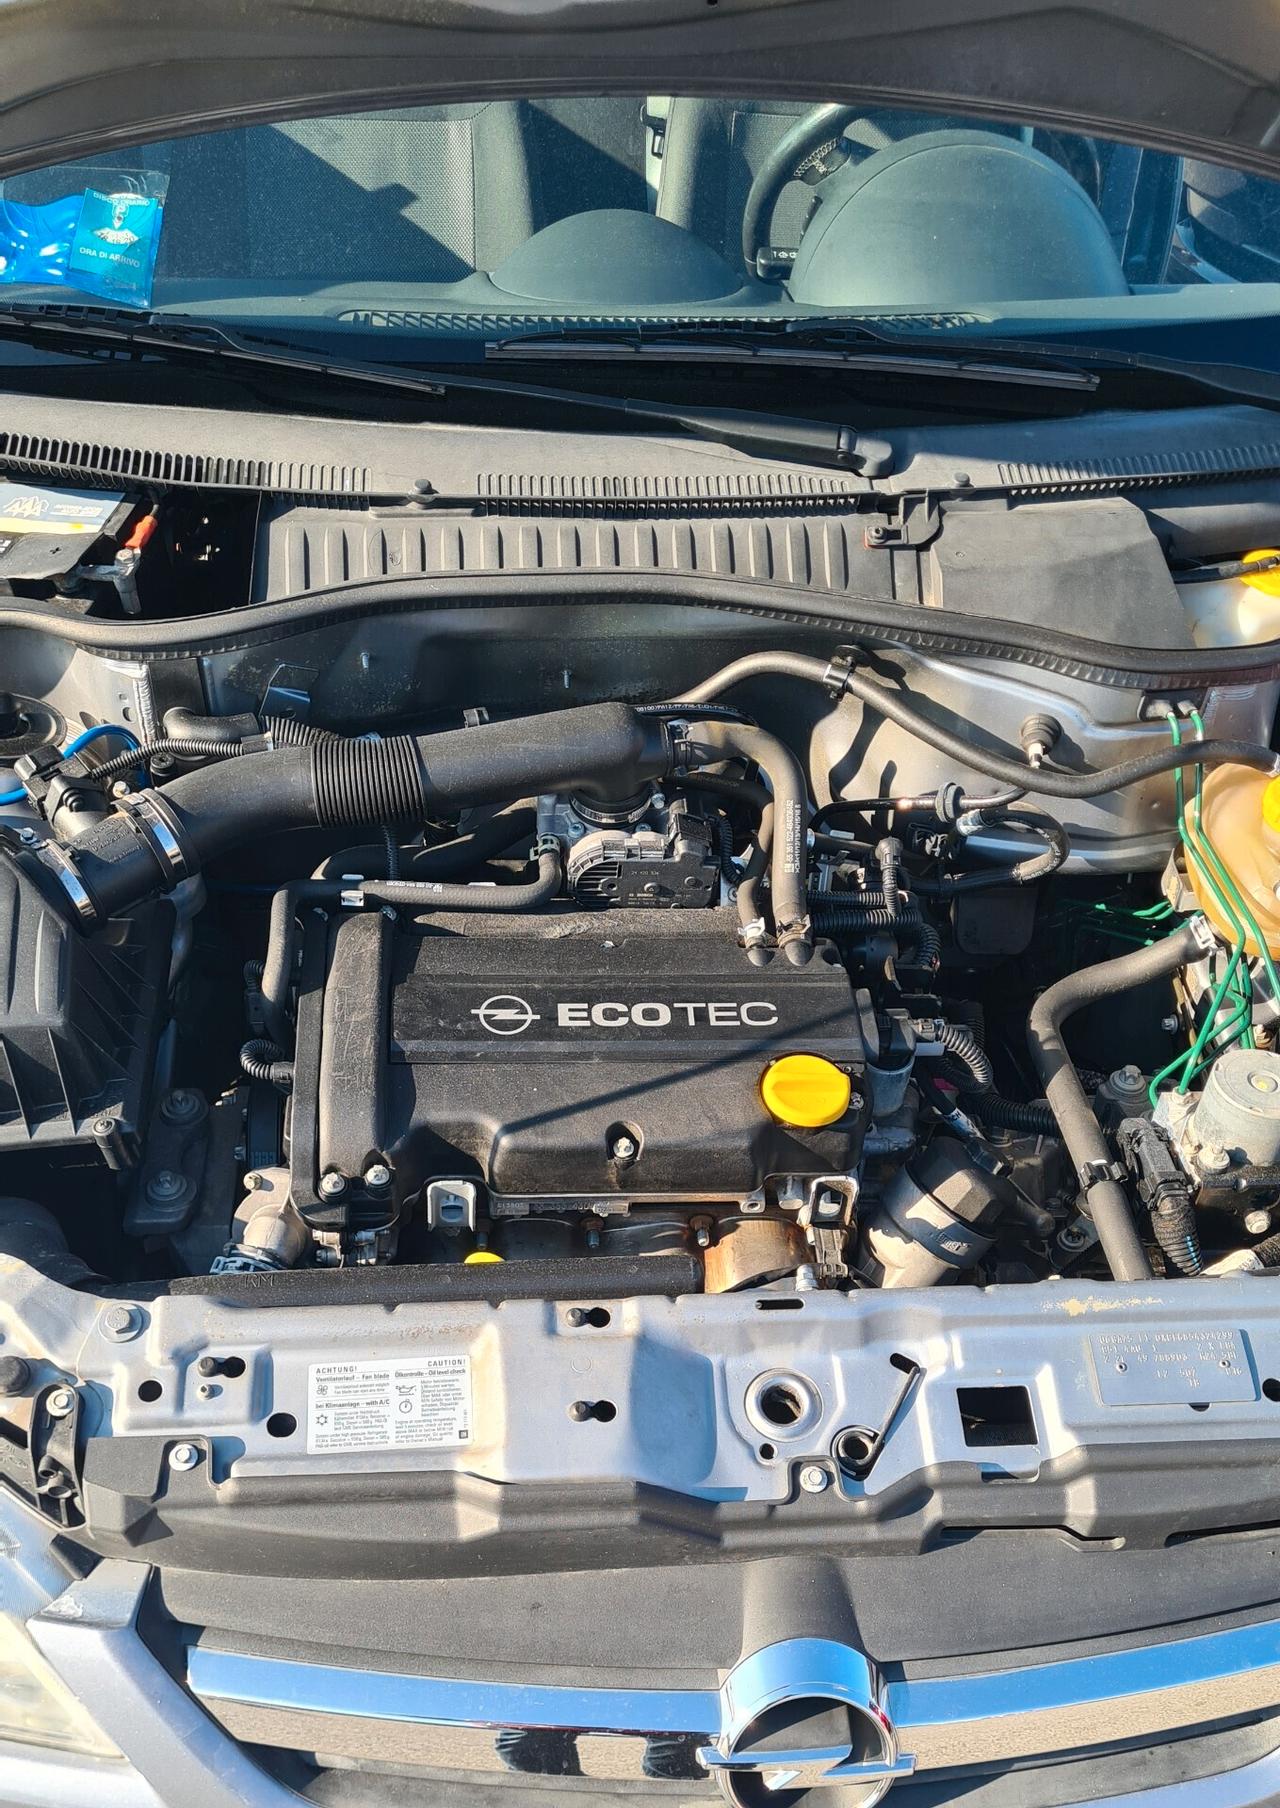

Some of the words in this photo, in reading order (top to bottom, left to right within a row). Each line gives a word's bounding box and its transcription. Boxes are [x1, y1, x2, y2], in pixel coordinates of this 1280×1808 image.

[80, 246, 97, 257] ORA
[99, 251, 108, 259] DI
[109, 253, 140, 267] ARRIVO
[557, 1002, 779, 1027] ECOTEC
[428, 1359, 466, 1367] CAUTION!
[316, 1366, 357, 1374] ACHTUNG!
[379, 1398, 390, 1406] A/C
